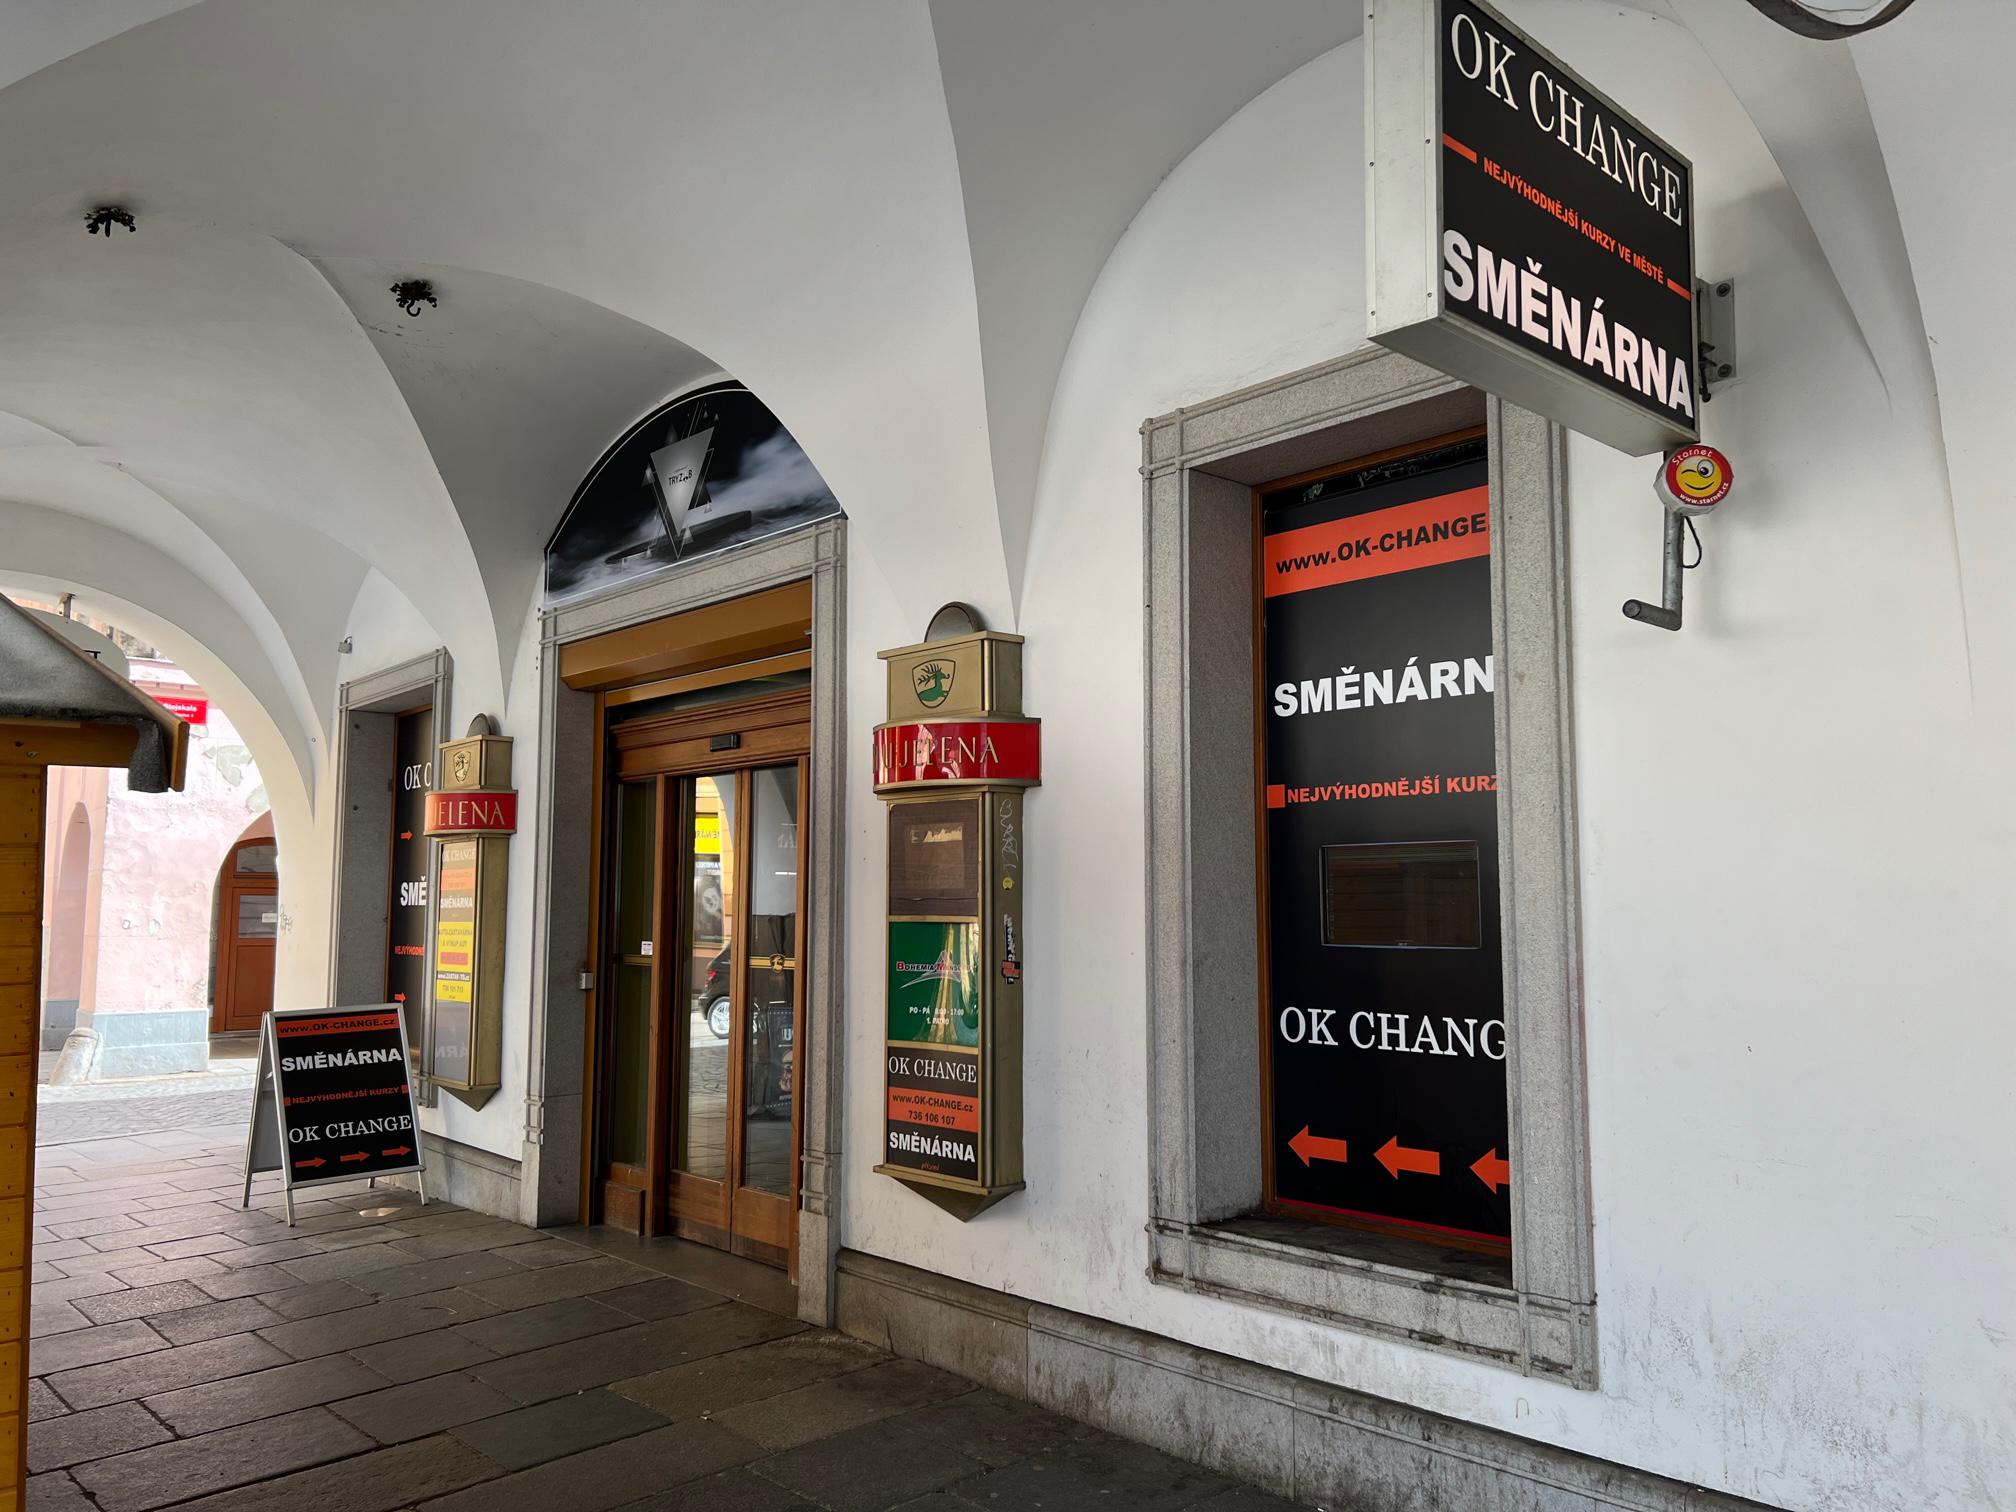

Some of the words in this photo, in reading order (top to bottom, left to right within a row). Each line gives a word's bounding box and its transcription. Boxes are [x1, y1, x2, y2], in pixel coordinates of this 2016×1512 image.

[1450, 13, 1519, 110] OK
[1529, 70, 1683, 226] CHANGE
[1483, 157, 1580, 230] NEJVÝHODNĚJŠÍ
[1581, 220, 1616, 251] KURZY
[1618, 242, 1632, 264] VE
[1444, 228, 1694, 419] SMĚNÁRNA
[1671, 448, 1713, 466] Starnet
[1679, 482, 1729, 504] www.starnet.cz
[1273, 655, 1495, 718] SMĚNÁRN
[404, 763, 422, 791] OK
[1287, 775, 1440, 804] NEJVÝHODNĚJŠÍ
[909, 1006, 918, 1014] PO
[279, 1018, 396, 1034] www.OK-CHANGE.cz
[1280, 1006, 1338, 1046] OK
[1349, 1011, 1506, 1060] CHANG
[281, 1047, 403, 1072] SMĚNÁRNA
[889, 1056, 910, 1076] OK
[914, 1058, 977, 1083] CHANGE
[369, 1086, 400, 1096] KURZY
[892, 1093, 974, 1113] www.OK-CHANGE.cz
[288, 1126, 321, 1144] OK
[325, 1115, 412, 1139] CHANGE
[908, 1110, 922, 1120] 736
[925, 1113, 939, 1122] 106
[941, 1116, 955, 1125] 107
[889, 1131, 975, 1163] SMĚNÁRNA
